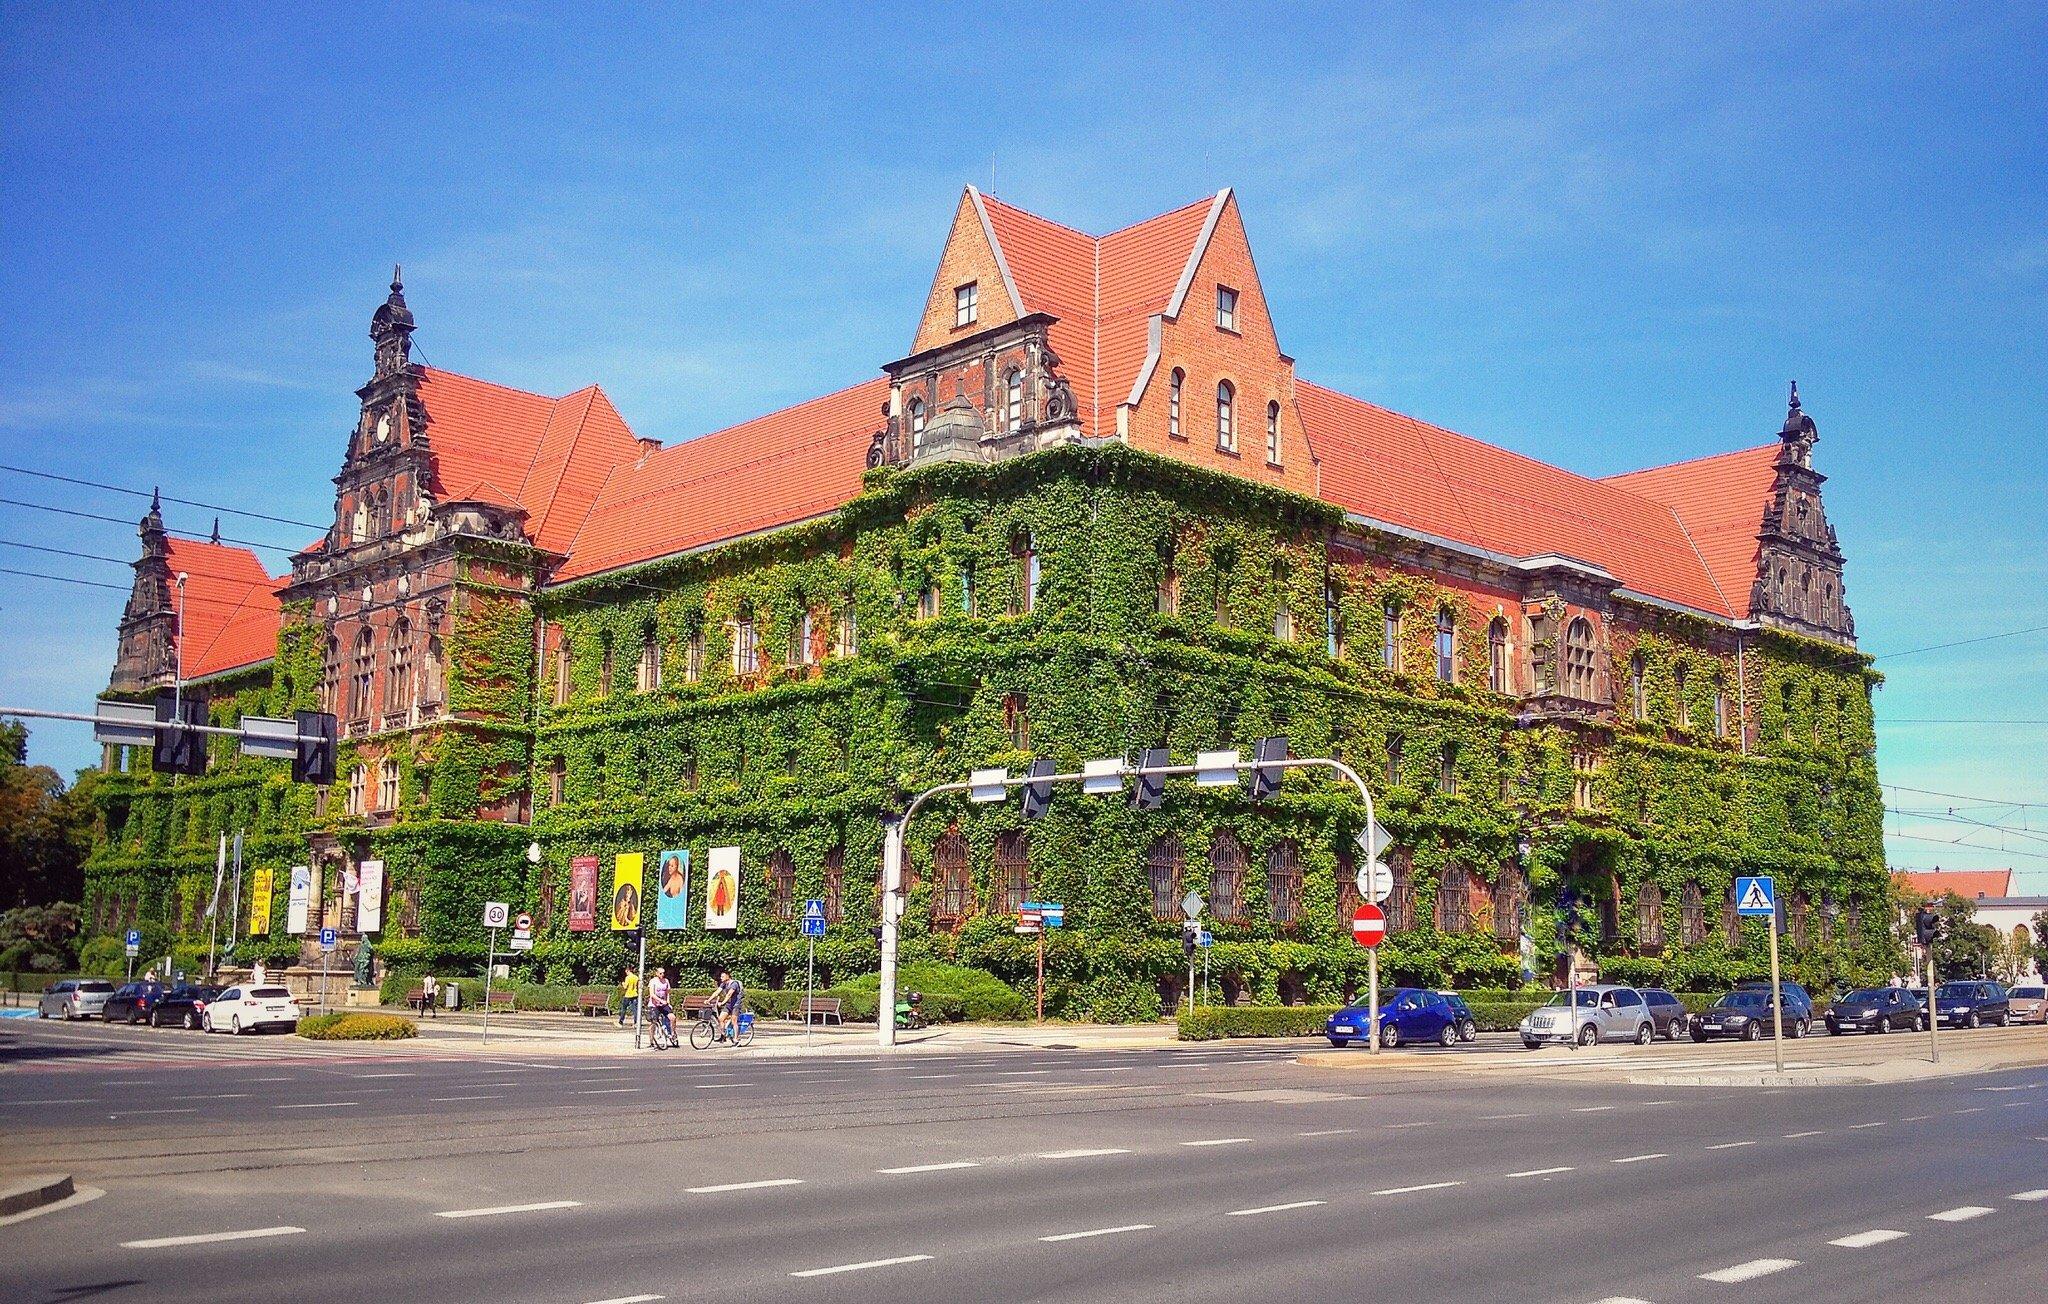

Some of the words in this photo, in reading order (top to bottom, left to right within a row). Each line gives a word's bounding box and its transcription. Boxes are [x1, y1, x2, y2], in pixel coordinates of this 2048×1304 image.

[491, 910, 503, 919] 30
[130, 931, 138, 941] P
[324, 931, 333, 943] P
